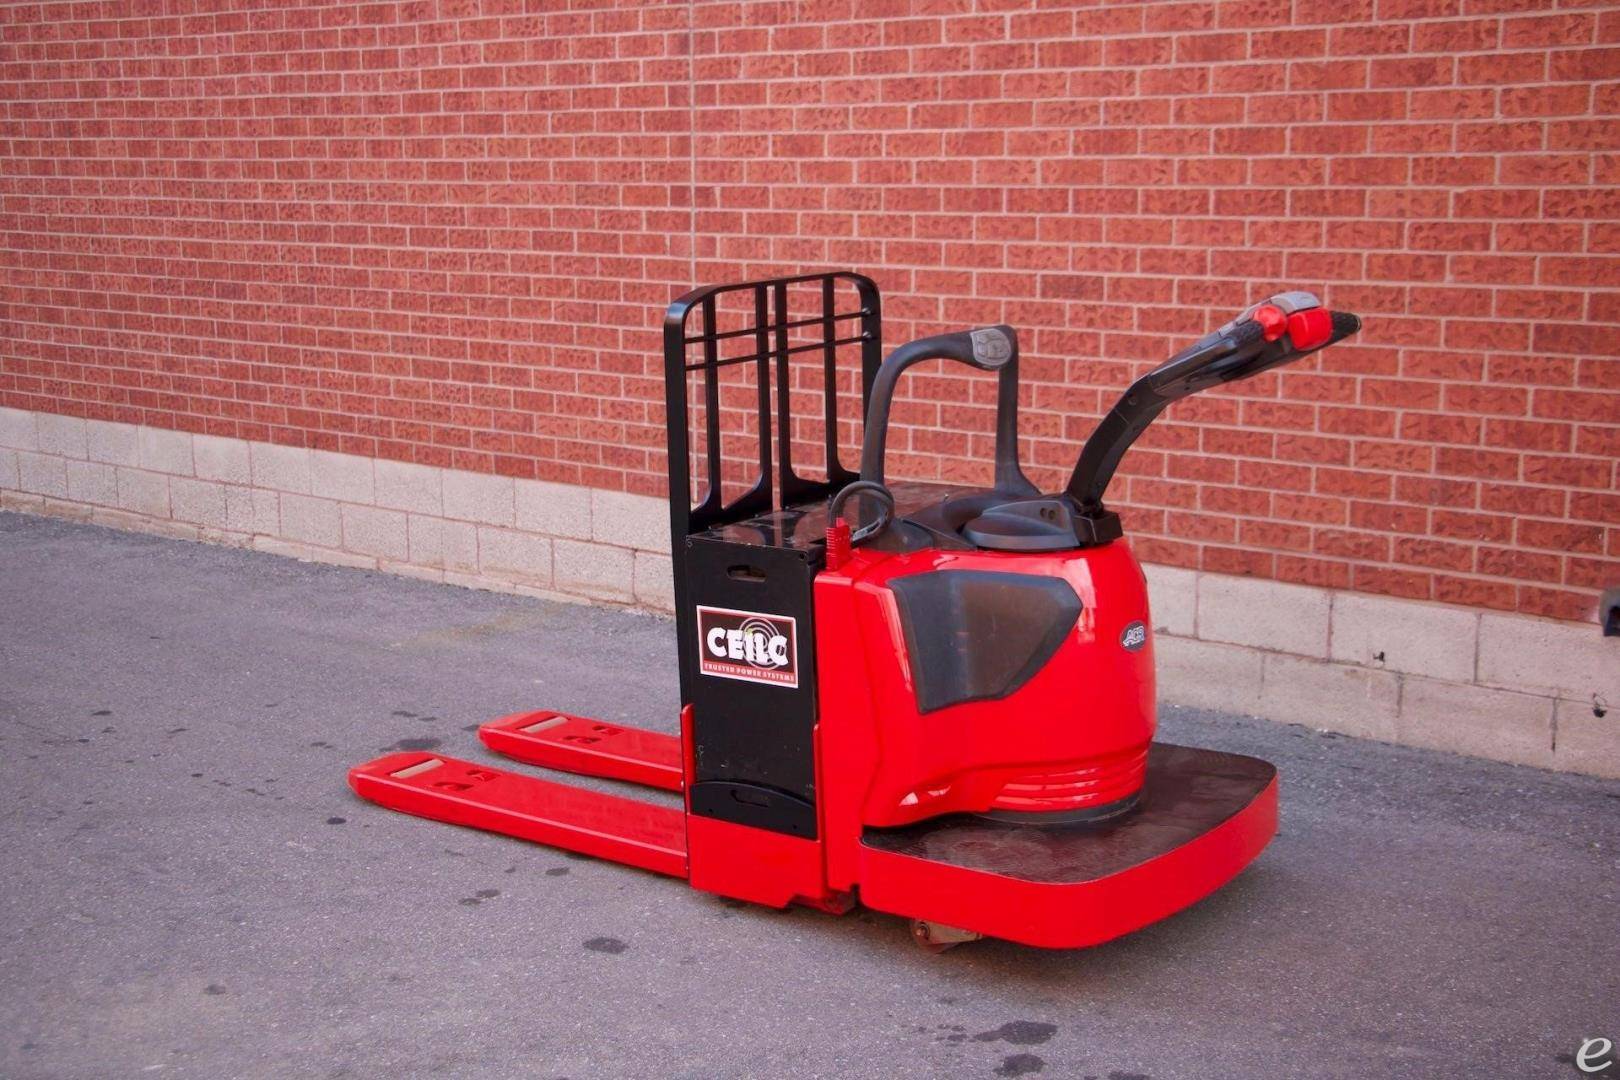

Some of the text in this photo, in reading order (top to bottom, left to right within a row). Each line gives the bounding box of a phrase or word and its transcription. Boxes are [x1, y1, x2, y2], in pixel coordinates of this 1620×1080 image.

[704, 663, 795, 682] TRUSTED POWER SYSTEMS
